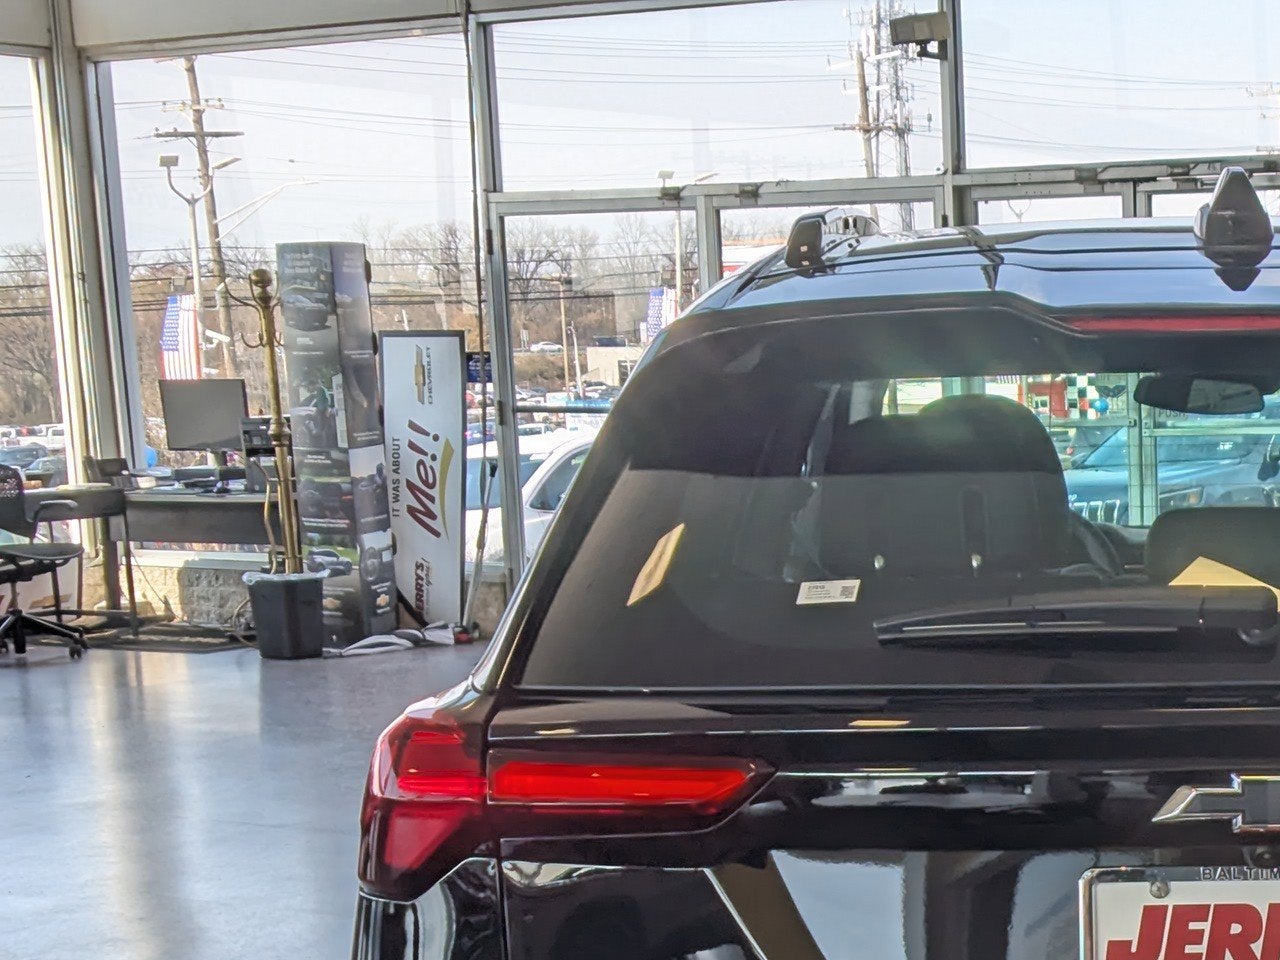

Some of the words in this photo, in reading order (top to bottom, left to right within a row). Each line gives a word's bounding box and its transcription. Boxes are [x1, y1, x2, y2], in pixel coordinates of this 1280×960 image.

[391, 437, 401, 475] ABOUT
[392, 478, 400, 503] WAS
[406, 419, 441, 538] Me!!
[392, 507, 400, 517] IT
[415, 560, 424, 611] ERRY'S
